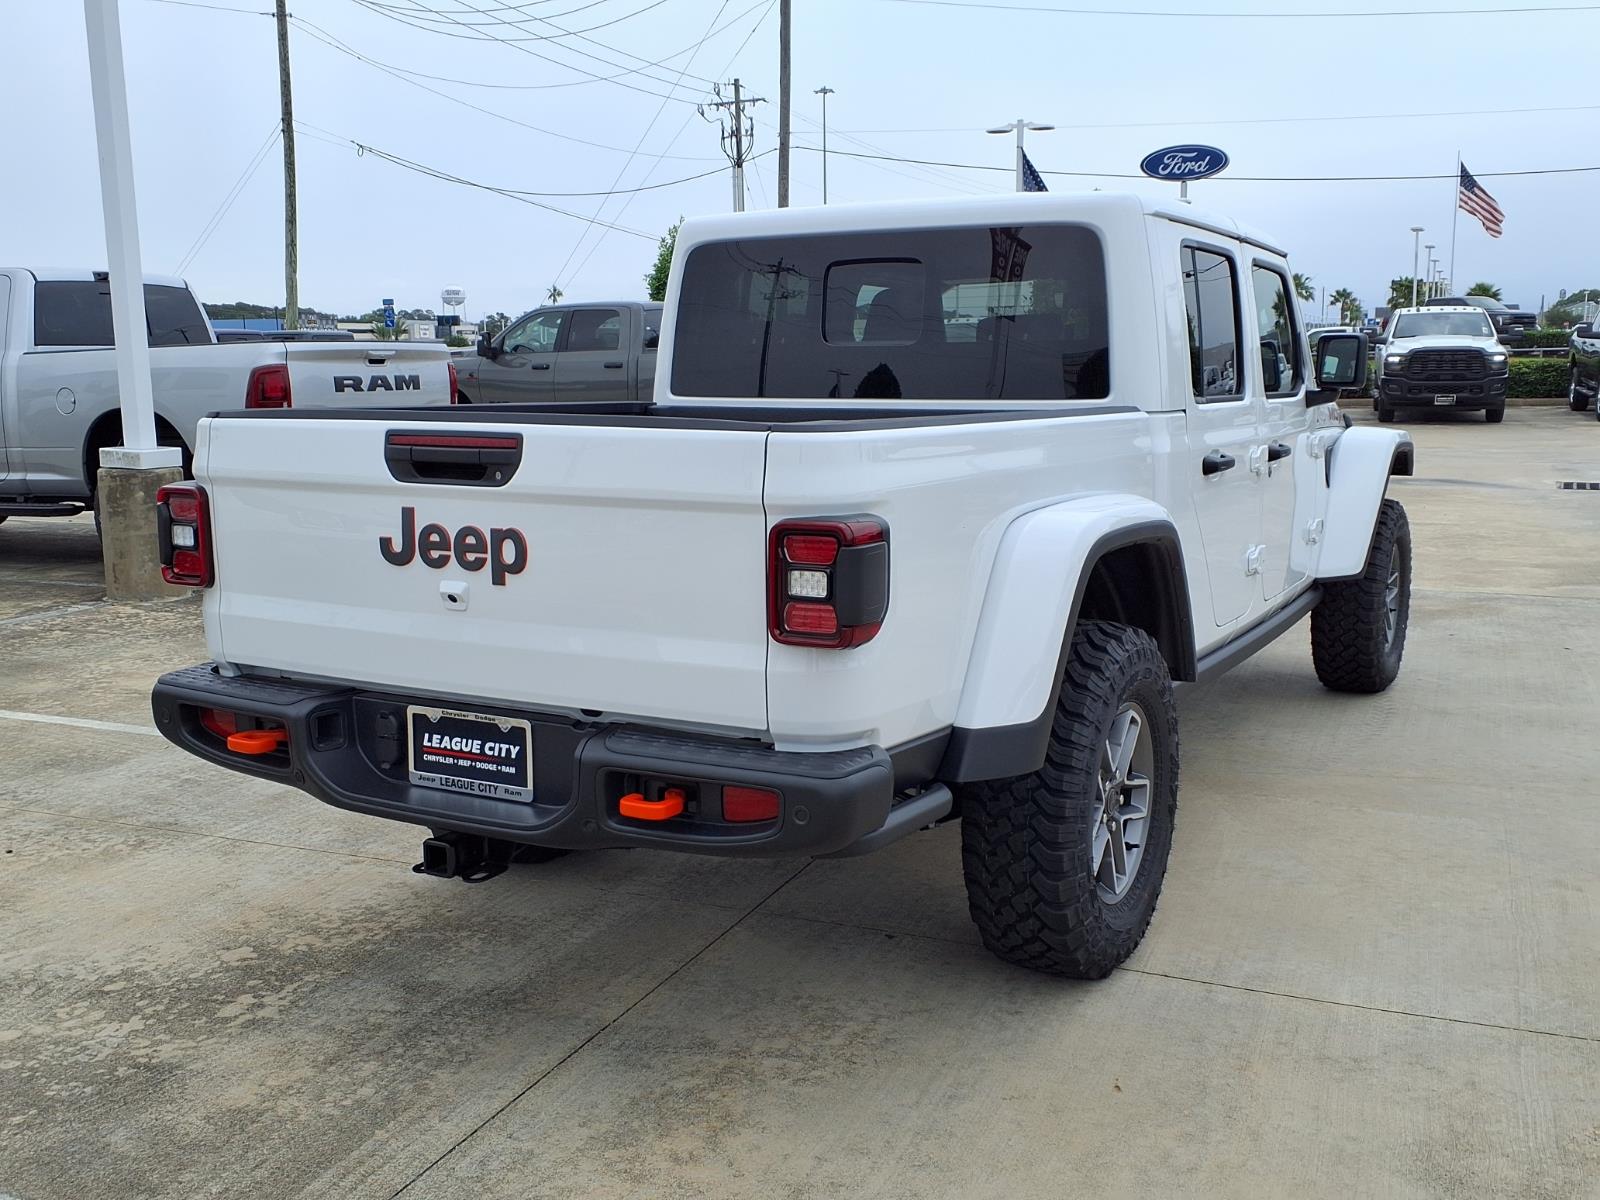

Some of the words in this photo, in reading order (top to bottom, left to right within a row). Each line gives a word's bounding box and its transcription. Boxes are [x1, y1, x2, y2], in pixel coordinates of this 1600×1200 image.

[1158, 152, 1211, 175] Ford
[333, 375, 421, 392] RAM
[379, 506, 528, 586] Jeep
[441, 710, 469, 719] Chrysler
[474, 714, 496, 722] Dodge
[423, 733, 482, 754] LEAGUE
[484, 742, 520, 759] CITY
[423, 754, 454, 765] CHRYSLER
[457, 758, 472, 767] JEEP
[475, 761, 497, 771] DODGE
[501, 765, 516, 774] RAM
[417, 774, 436, 783] Jeep
[439, 776, 476, 791] LEAGUE
[478, 783, 499, 795] CITY
[504, 788, 522, 797] Ram
